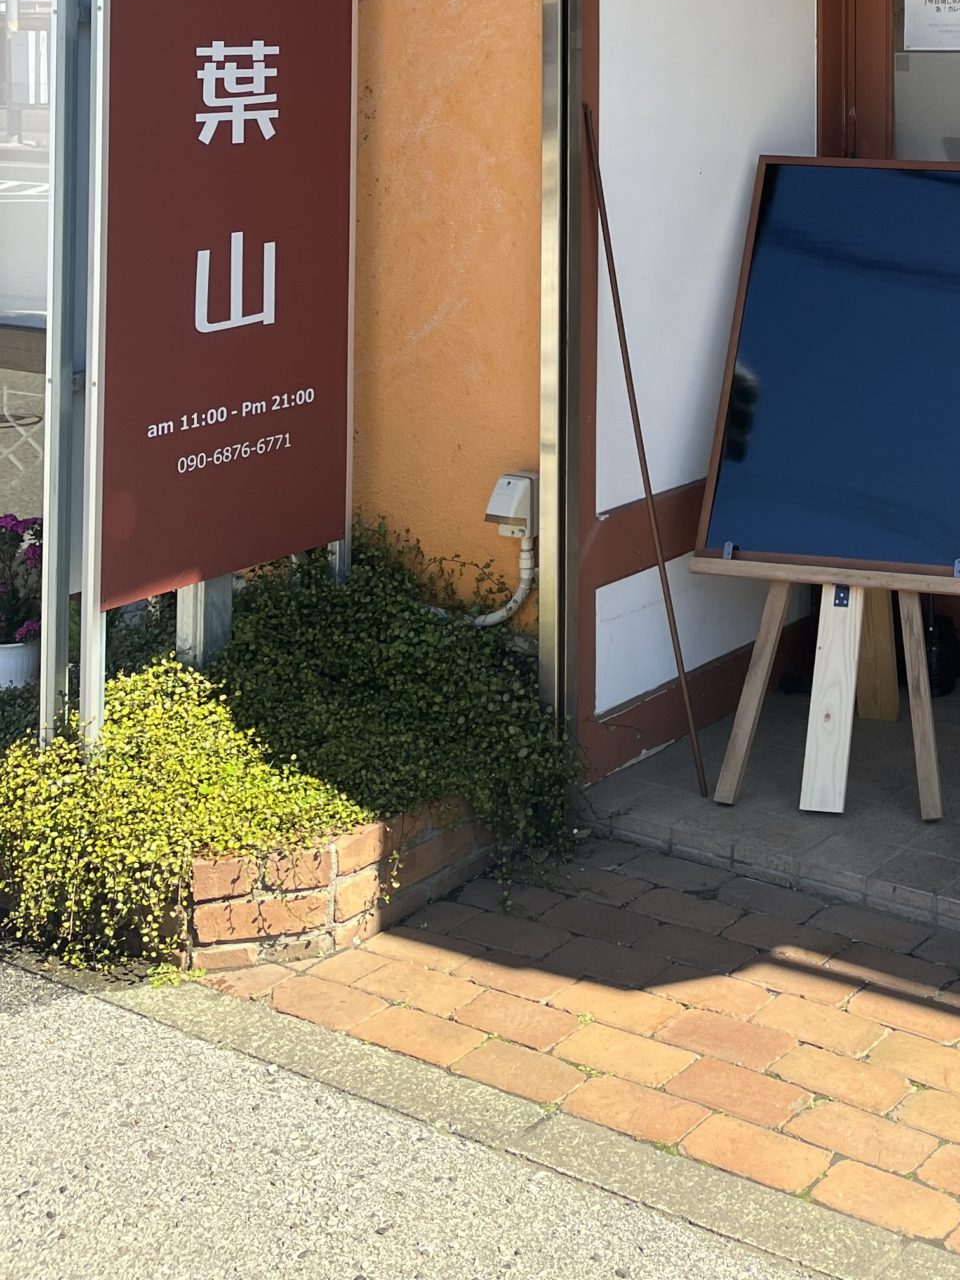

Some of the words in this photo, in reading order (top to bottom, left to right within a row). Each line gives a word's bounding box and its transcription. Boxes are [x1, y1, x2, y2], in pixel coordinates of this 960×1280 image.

[194, 39, 281, 334] 葉山
[147, 420, 174, 438] am
[180, 406, 227, 431] 11:00
[242, 401, 266, 417] Pm
[271, 388, 315, 411] 21:00
[177, 433, 292, 473] 090-6876-6771
